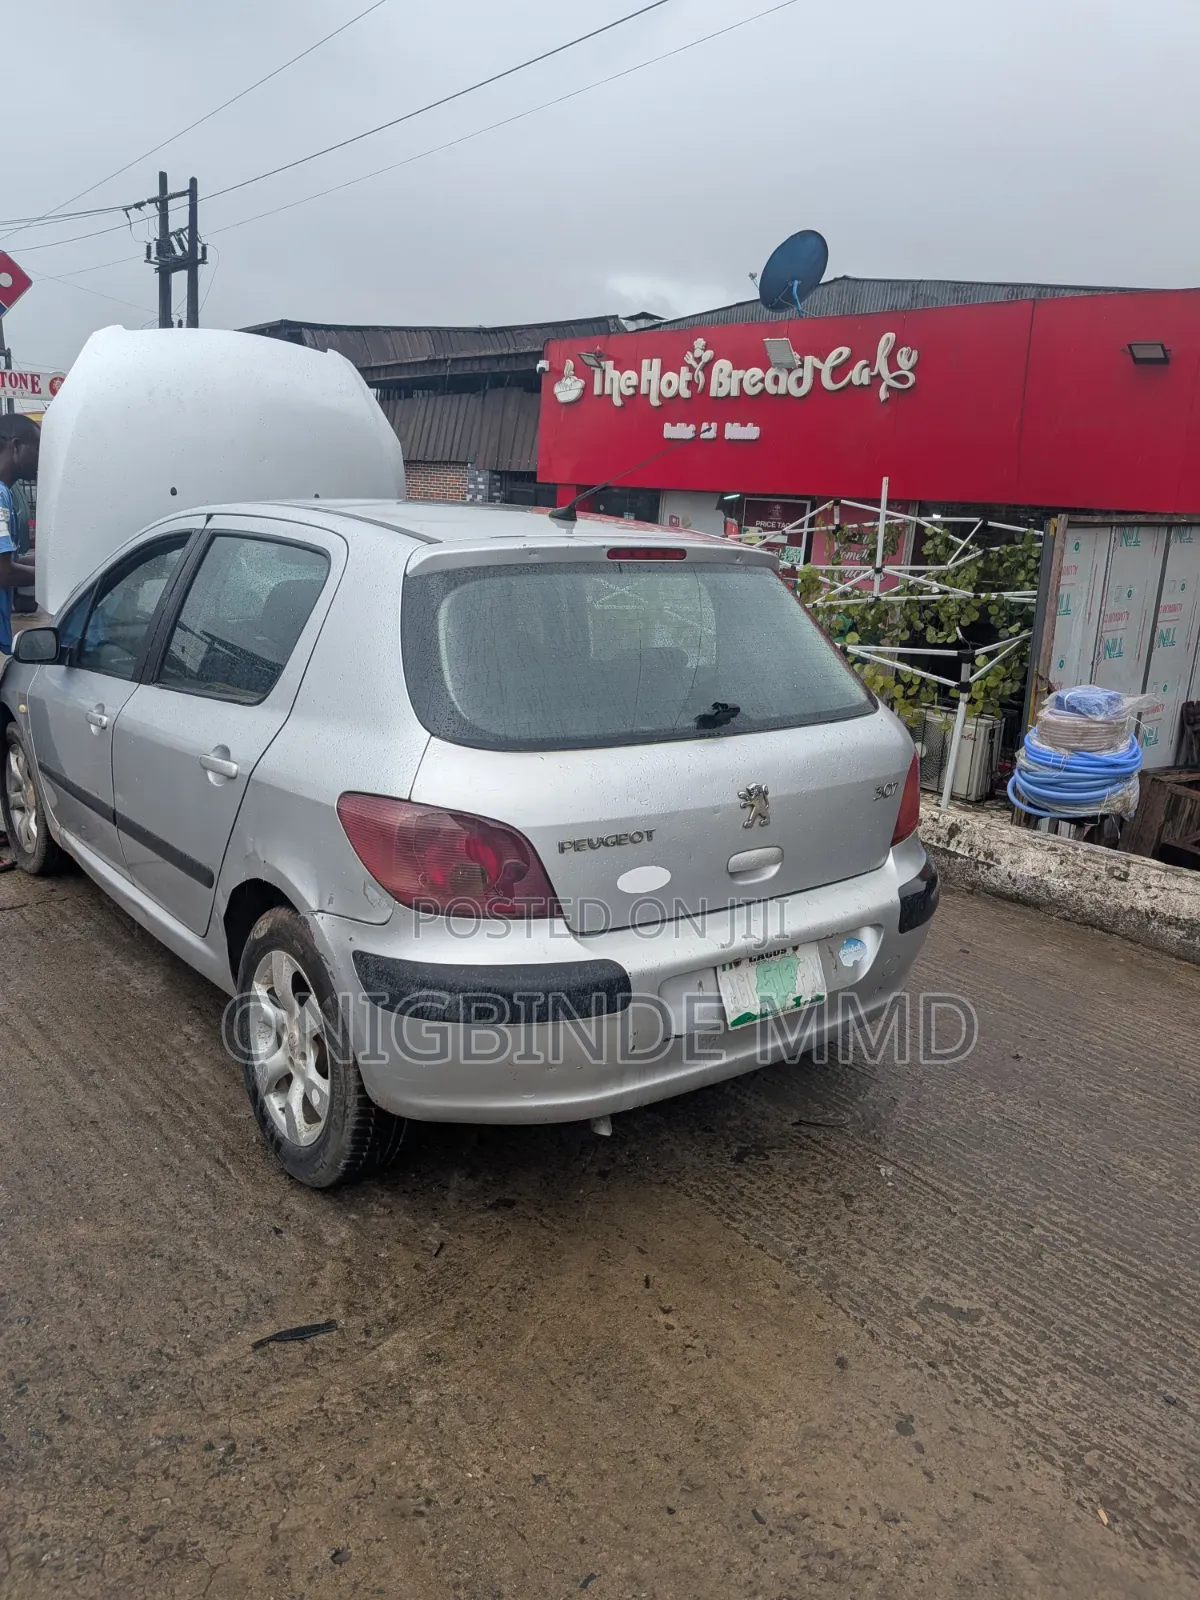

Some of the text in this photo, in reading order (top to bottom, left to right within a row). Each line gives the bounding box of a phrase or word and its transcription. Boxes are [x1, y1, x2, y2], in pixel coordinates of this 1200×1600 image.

[591, 358, 638, 407] The
[640, 358, 692, 407] Hot
[710, 355, 814, 397] Bread
[755, 520, 777, 528] PRICE
[873, 782, 899, 802] 307
[558, 828, 656, 854] PEUGEOT
